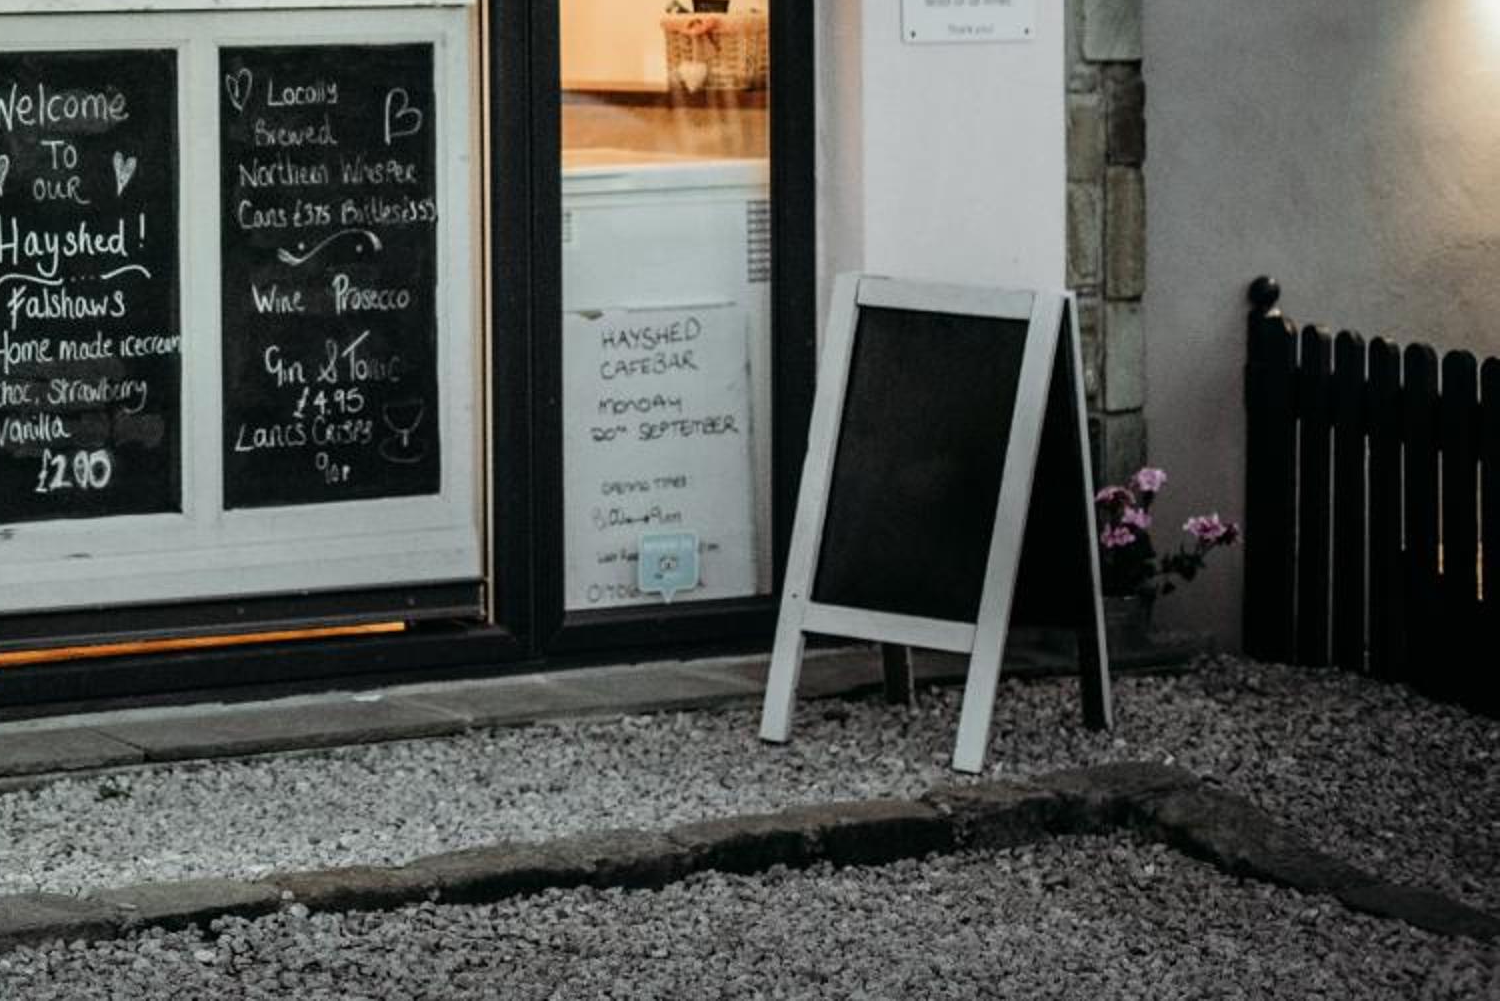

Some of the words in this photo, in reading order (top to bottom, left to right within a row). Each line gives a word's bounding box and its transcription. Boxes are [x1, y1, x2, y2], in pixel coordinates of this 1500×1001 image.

[267, 76, 338, 107] Locally
[254, 112, 339, 147] Brewed
[238, 152, 329, 187] Northern
[238, 198, 288, 230] Cans
[6, 285, 126, 331] Falshaws
[251, 282, 307, 315] Wine
[332, 273, 411, 316] Prosecco
[601, 316, 702, 351] HAYSHED
[263, 344, 306, 388] Gin
[340, 329, 403, 383] Tonic
[47, 376, 148, 414] Strawberry
[292, 385, 365, 419] £4.95
[234, 422, 307, 452] Lancs
[638, 414, 740, 442] SEPTEMBER
